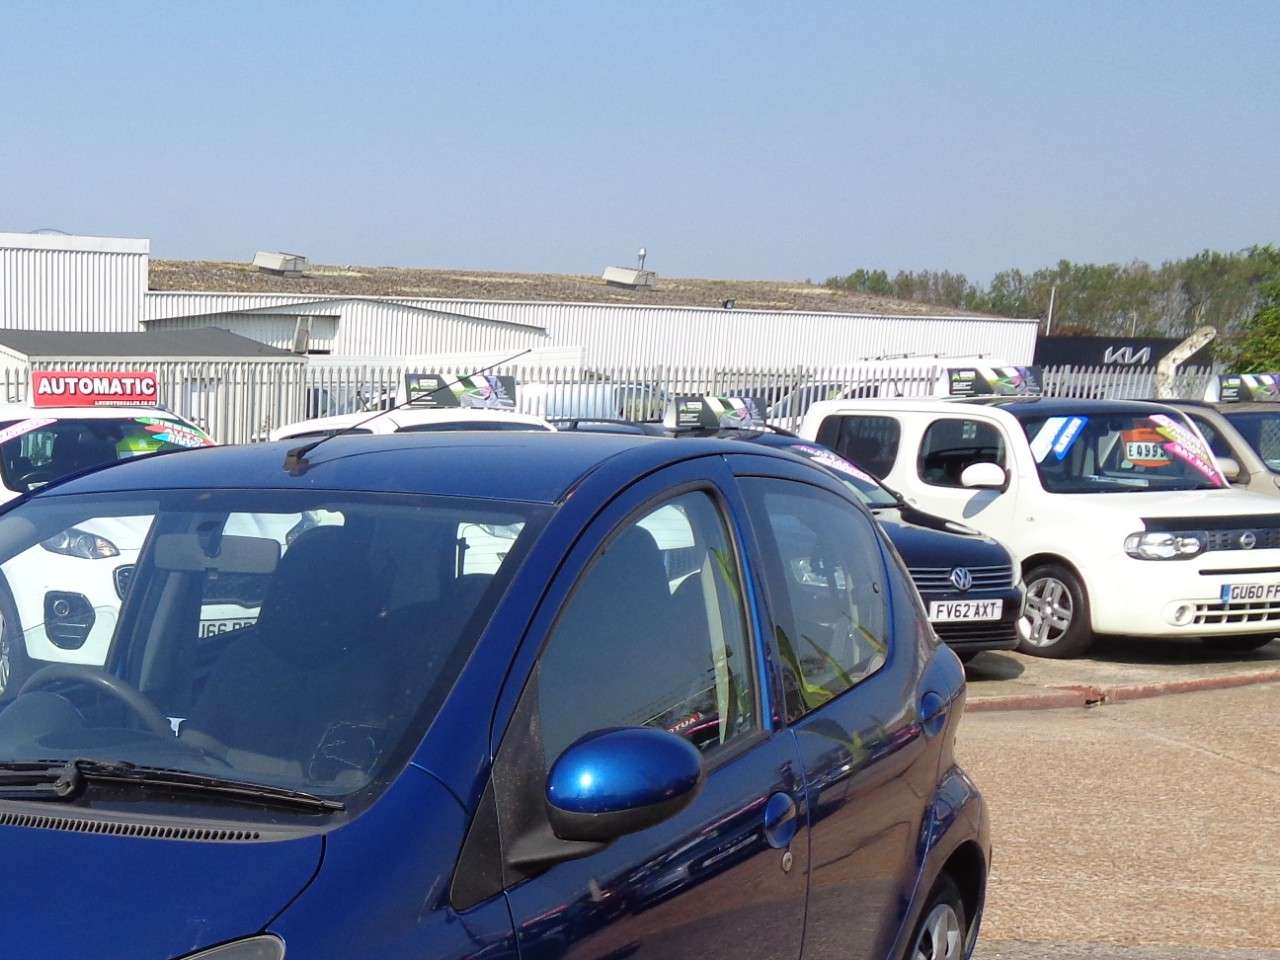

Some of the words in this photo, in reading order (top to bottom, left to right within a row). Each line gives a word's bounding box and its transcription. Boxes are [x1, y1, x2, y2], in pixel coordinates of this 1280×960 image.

[38, 378, 156, 395] AUTOMATIC
[1231, 584, 1263, 600] GU60
[936, 603, 972, 618] FV62
[974, 601, 997, 617] AXT
